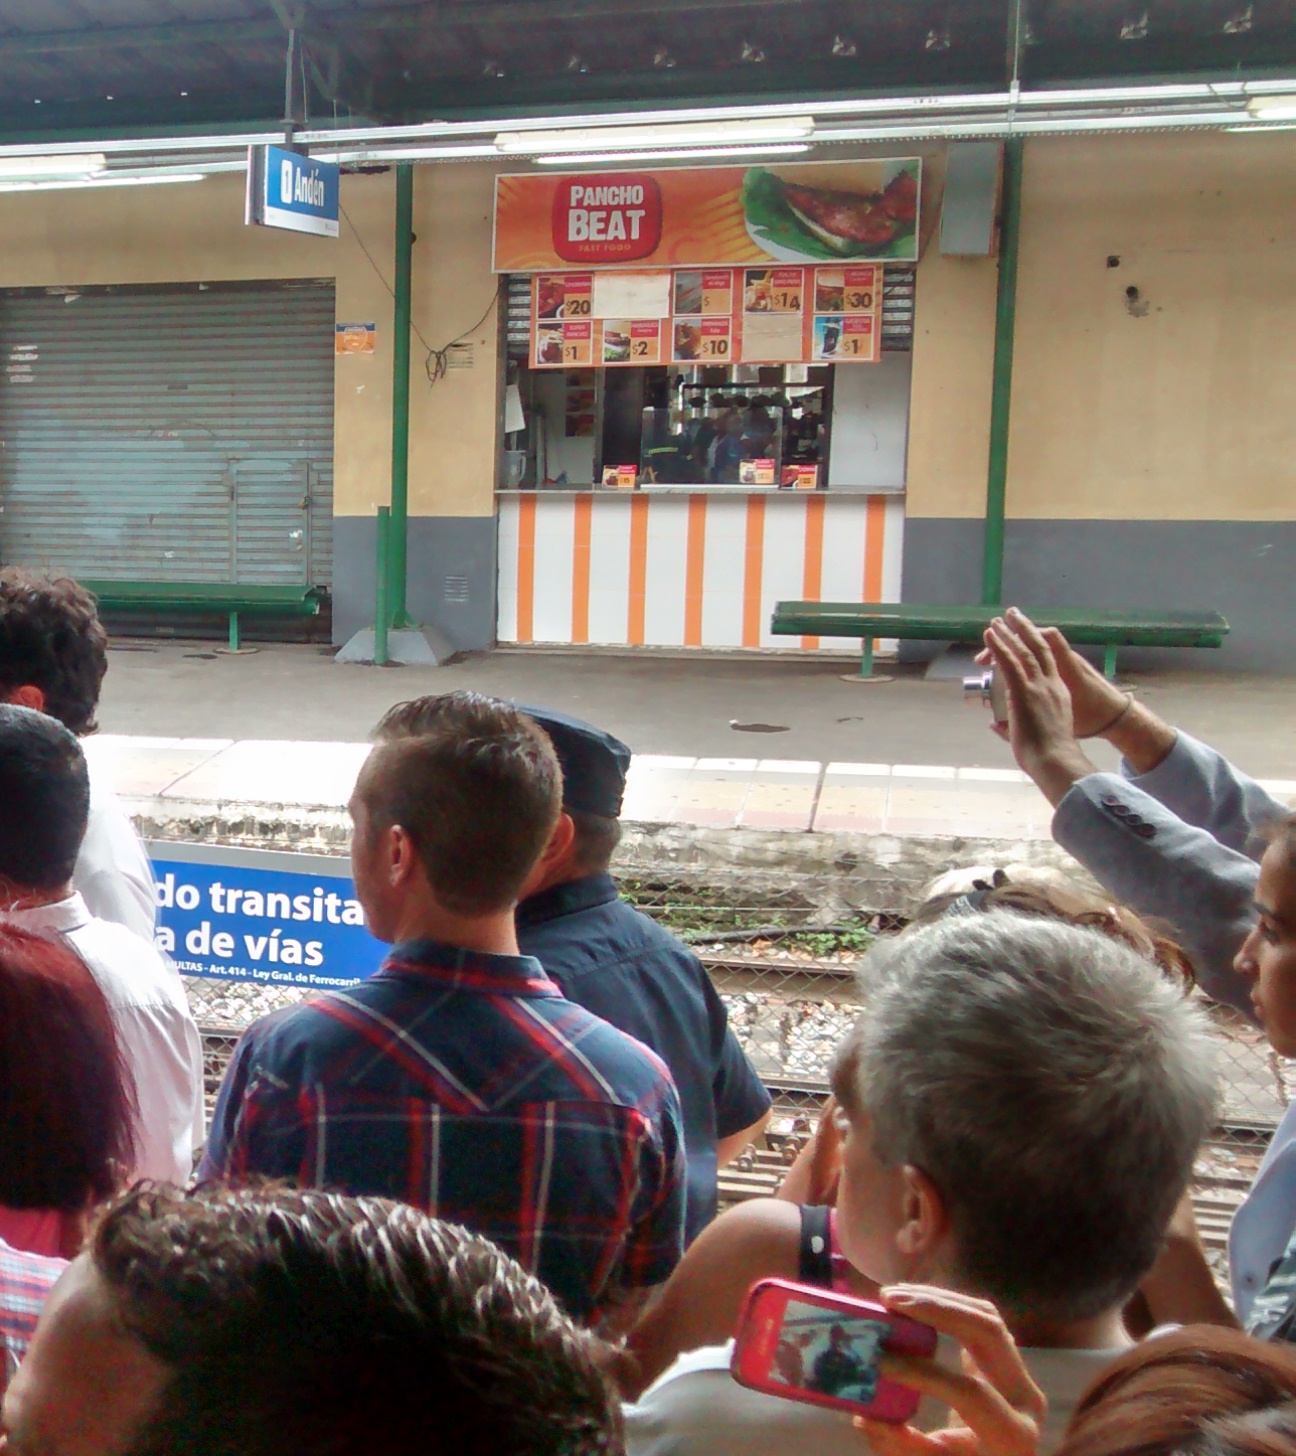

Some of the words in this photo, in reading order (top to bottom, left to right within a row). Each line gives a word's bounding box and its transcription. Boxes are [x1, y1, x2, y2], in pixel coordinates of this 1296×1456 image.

[294, 166, 324, 207] Andén
[570, 185, 644, 207] PANCHO
[568, 208, 645, 241] BEAT
[579, 244, 600, 252] FAST
[604, 243, 631, 251] FOOD
[566, 299, 591, 314] $20
[846, 292, 873, 308] $30
[565, 345, 577, 359] $1
[633, 341, 648, 356] $2
[703, 339, 728, 355] $10
[844, 339, 858, 354] $1
[209, 882, 364, 926] transita
[185, 921, 235, 958] de
[243, 928, 324, 967] vías
[228, 967, 246, 977] 414
[253, 969, 270, 982] Ley
[271, 971, 293, 984] Gral.
[295, 972, 308, 983] de
